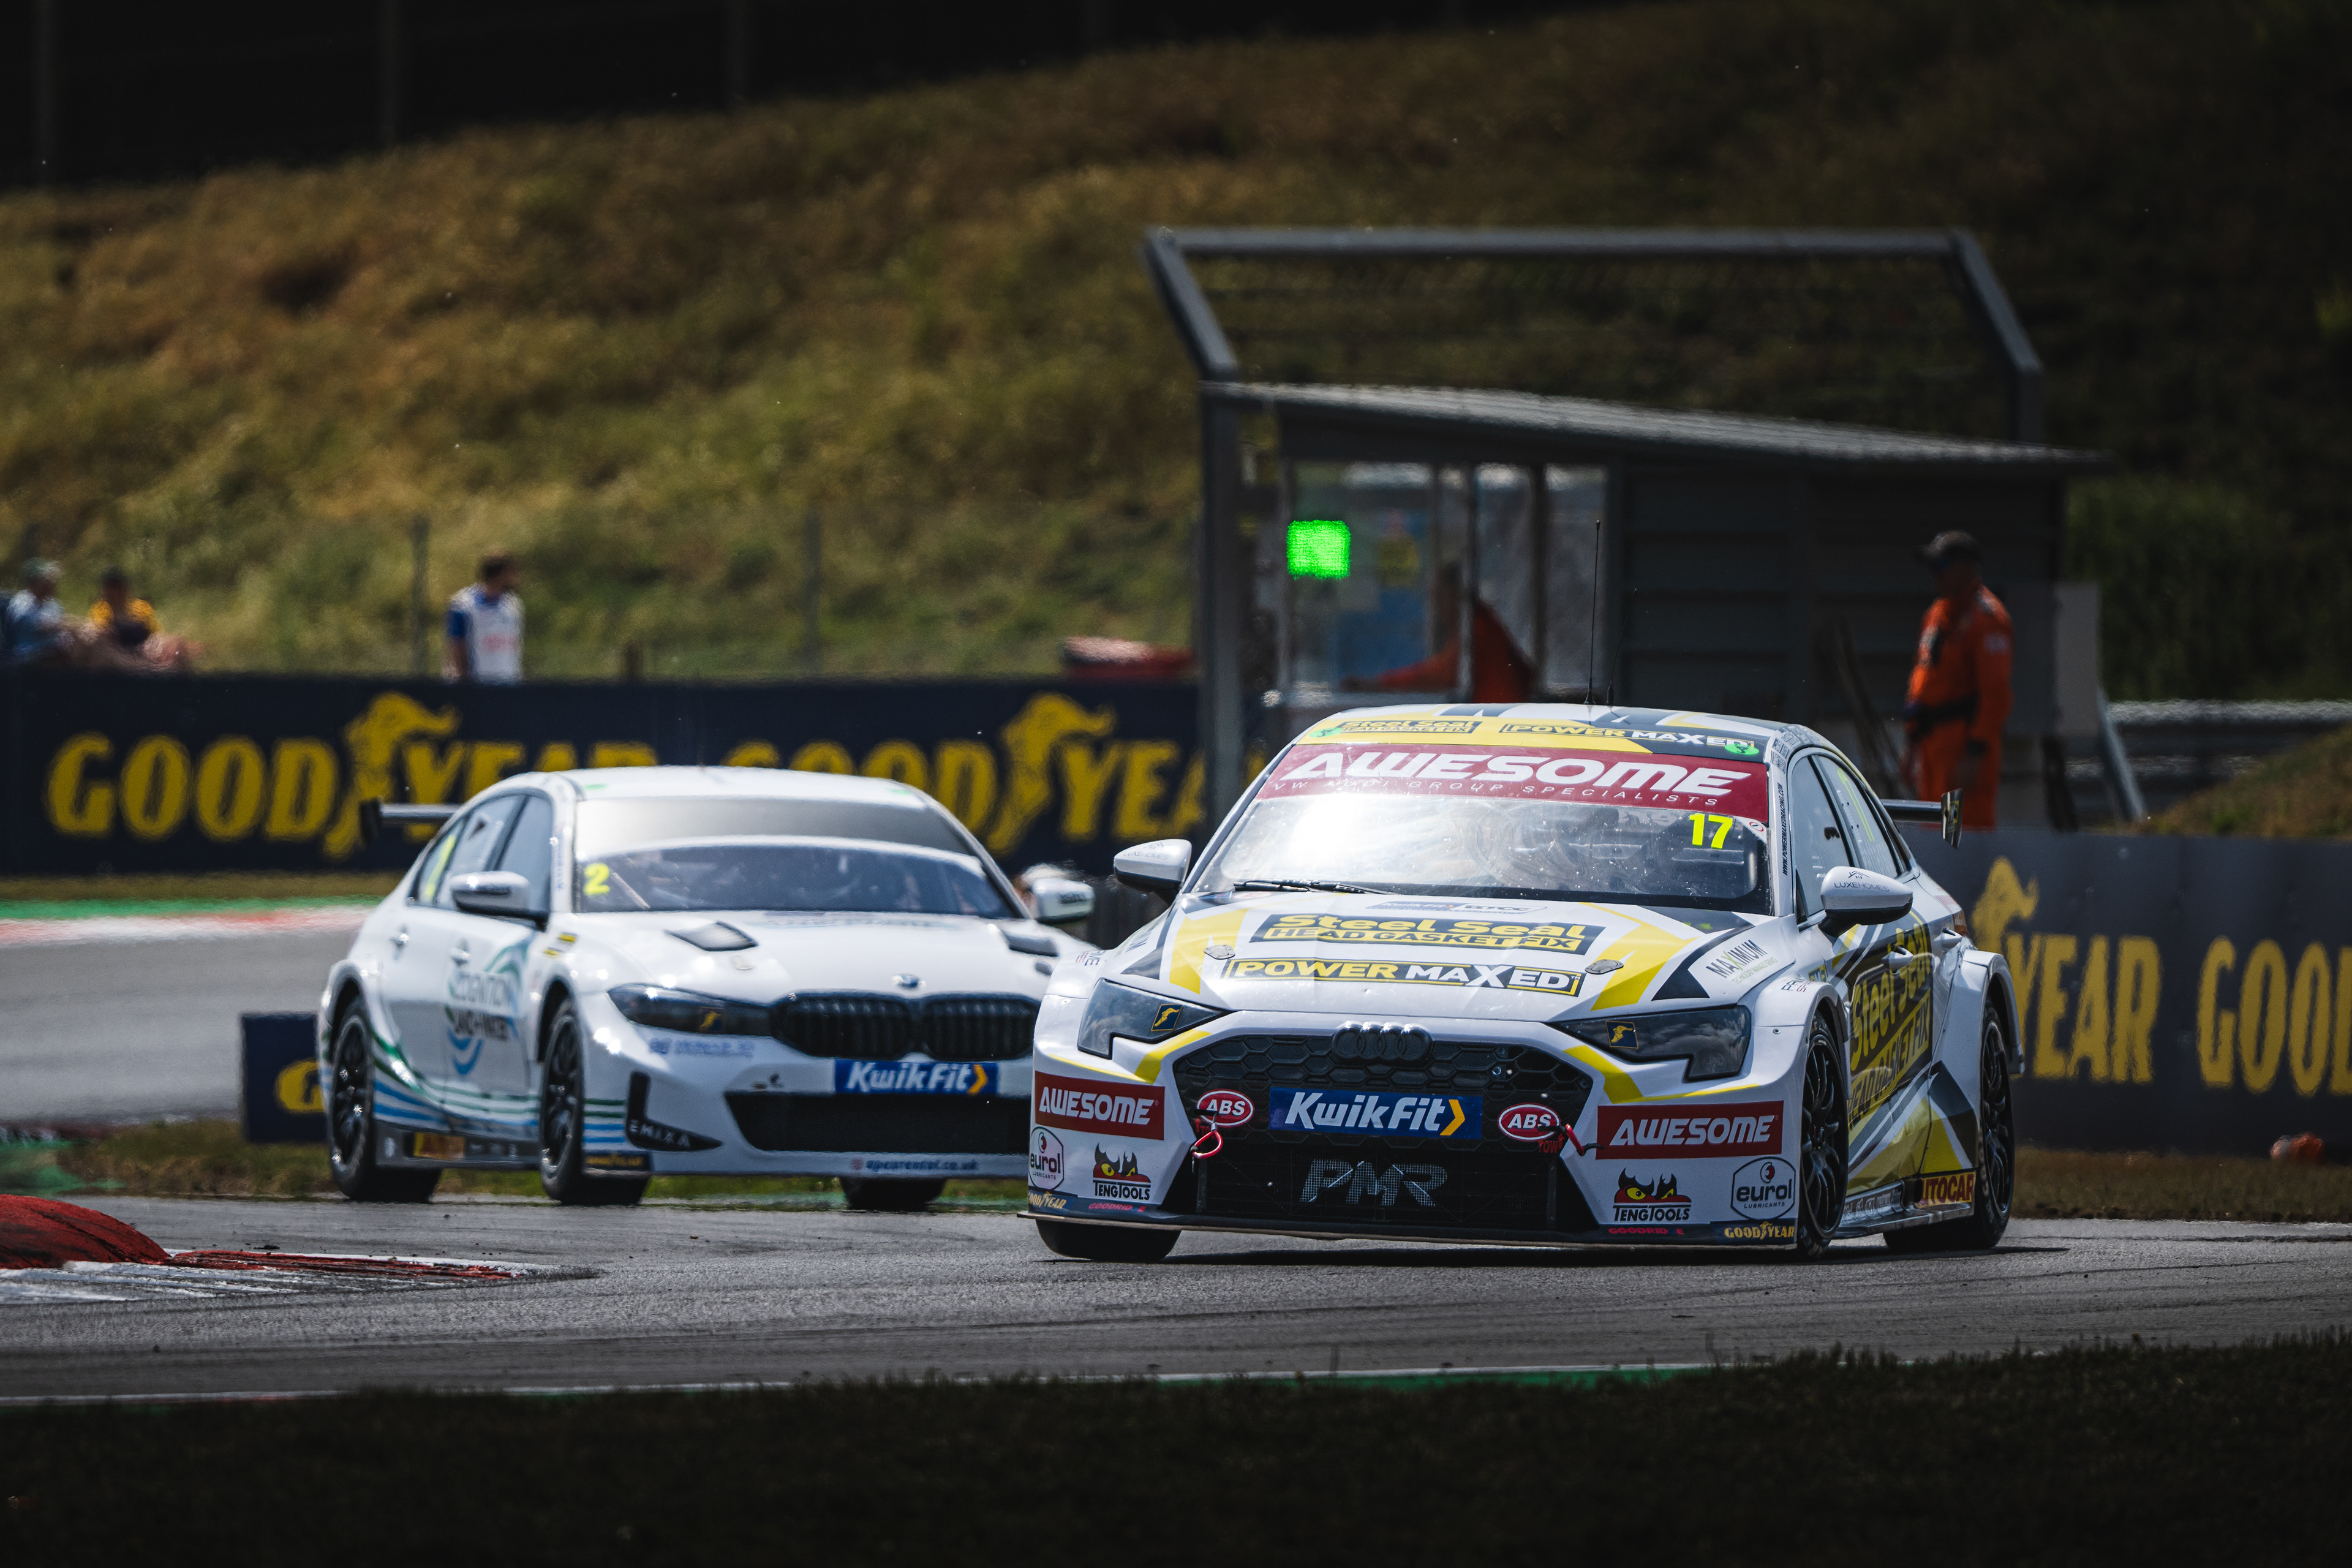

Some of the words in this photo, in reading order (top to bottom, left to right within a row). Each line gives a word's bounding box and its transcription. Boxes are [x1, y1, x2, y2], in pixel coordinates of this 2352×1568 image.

[1509, 725, 1626, 736] POWER
[1280, 752, 1752, 796] AWESOME
[1274, 781, 1308, 790] VW
[1409, 782, 1503, 792] GROUP
[1523, 785, 1718, 805] SPECIALISTS
[1689, 813, 1733, 849] 17
[582, 862, 610, 896] 2
[1833, 882, 1890, 892] LUXEHOMES
[1270, 929, 1366, 939] HEAD
[1373, 931, 1513, 945] GASKET
[1517, 937, 1576, 948] FIX
[1273, 914, 1437, 932] Steel
[1447, 921, 1586, 939] Seal
[1706, 939, 1768, 978] MAXIMUM
[1234, 961, 1398, 979] POWER
[1404, 964, 1570, 989] MAXED
[1039, 1087, 1155, 1125] AWESOME
[1206, 1099, 1246, 1116] ABS
[1285, 1092, 1446, 1131] KwikFit
[1507, 1114, 1551, 1129] ABS
[1609, 1115, 1776, 1146] AWESOME
[1537, 1139, 1558, 1153] TOW
[1030, 1152, 1061, 1174] eurol
[1032, 1171, 1057, 1180] LUBRICANTS
[1299, 1159, 1448, 1207] PMR
[1736, 1178, 1793, 1202] eurol
